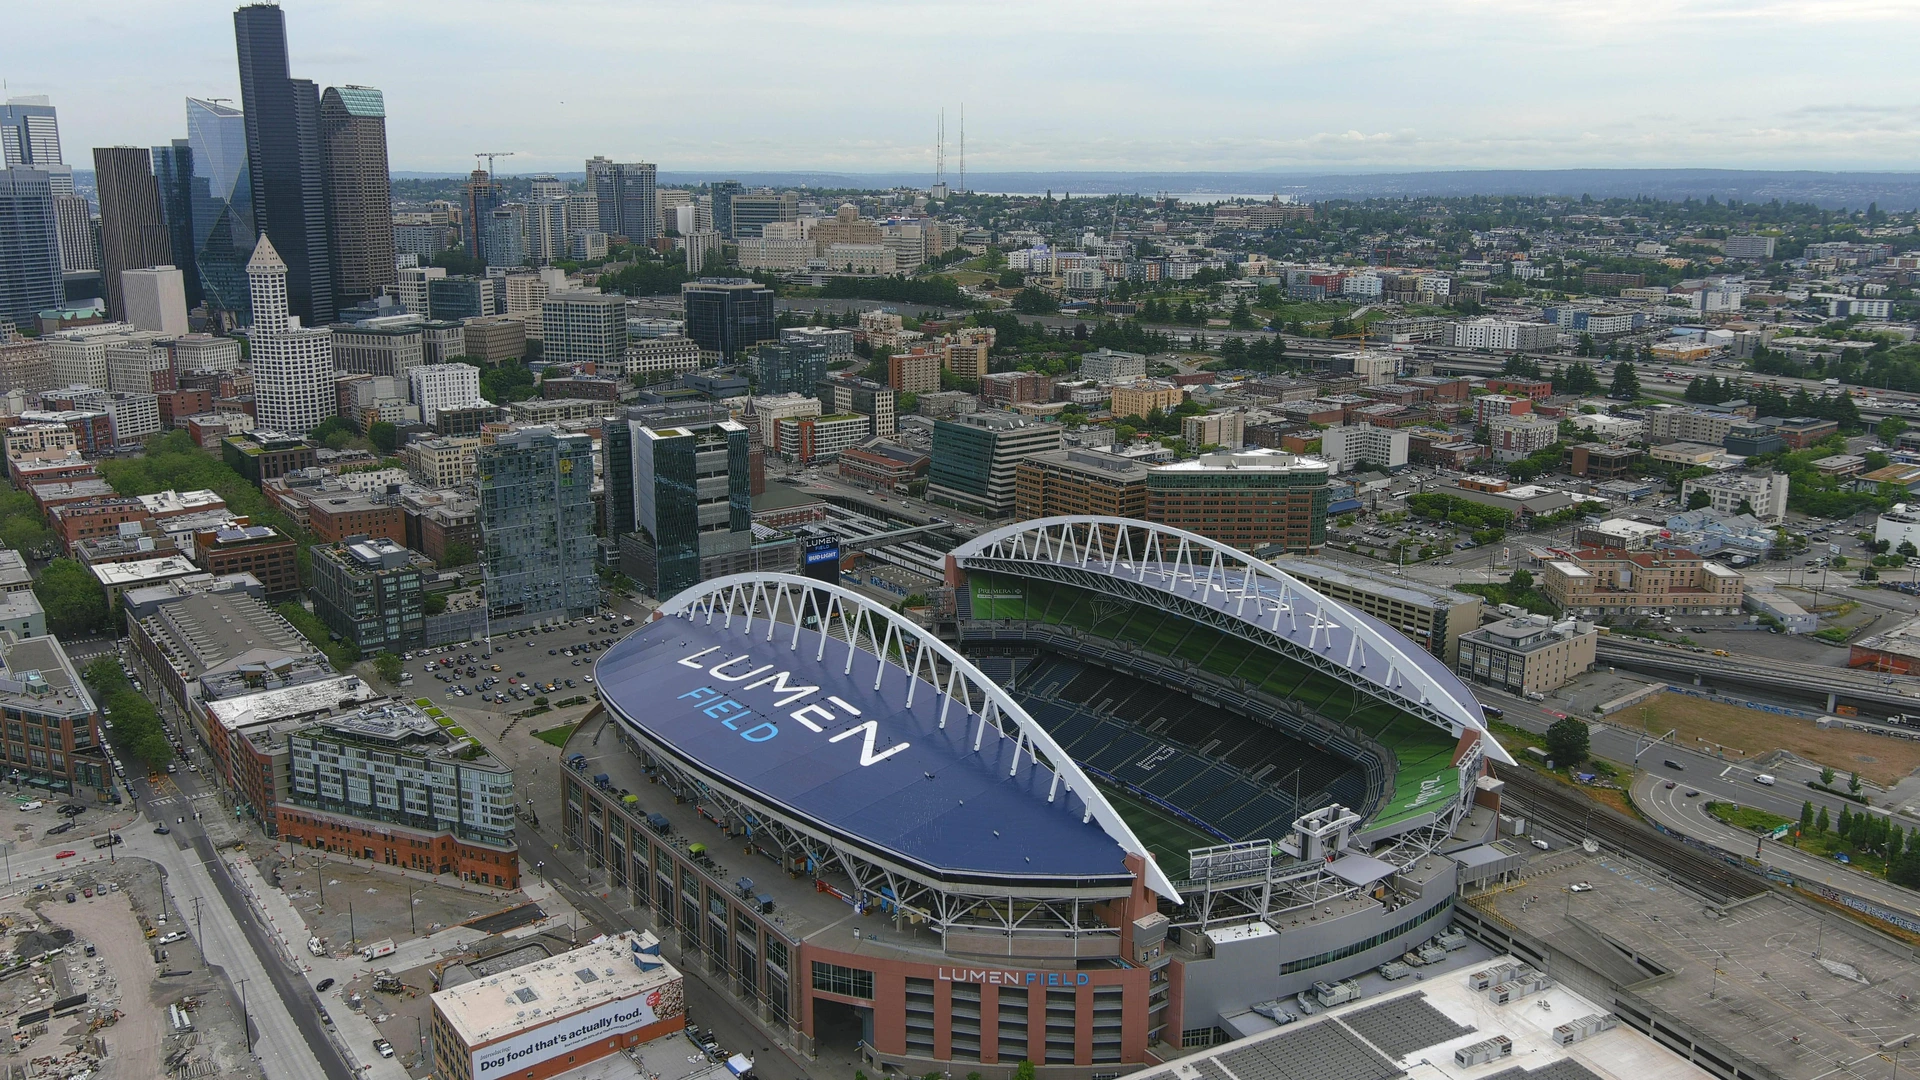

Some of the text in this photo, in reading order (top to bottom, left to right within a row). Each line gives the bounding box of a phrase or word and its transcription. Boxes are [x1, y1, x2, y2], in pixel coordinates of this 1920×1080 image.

[806, 536, 838, 547] LUMEN
[677, 646, 910, 766] LUMEN
[677, 687, 778, 742] FIELD
[939, 968, 1089, 986] LUMEN FIELD
[480, 1007, 643, 1072] Dog food that's actually food.
